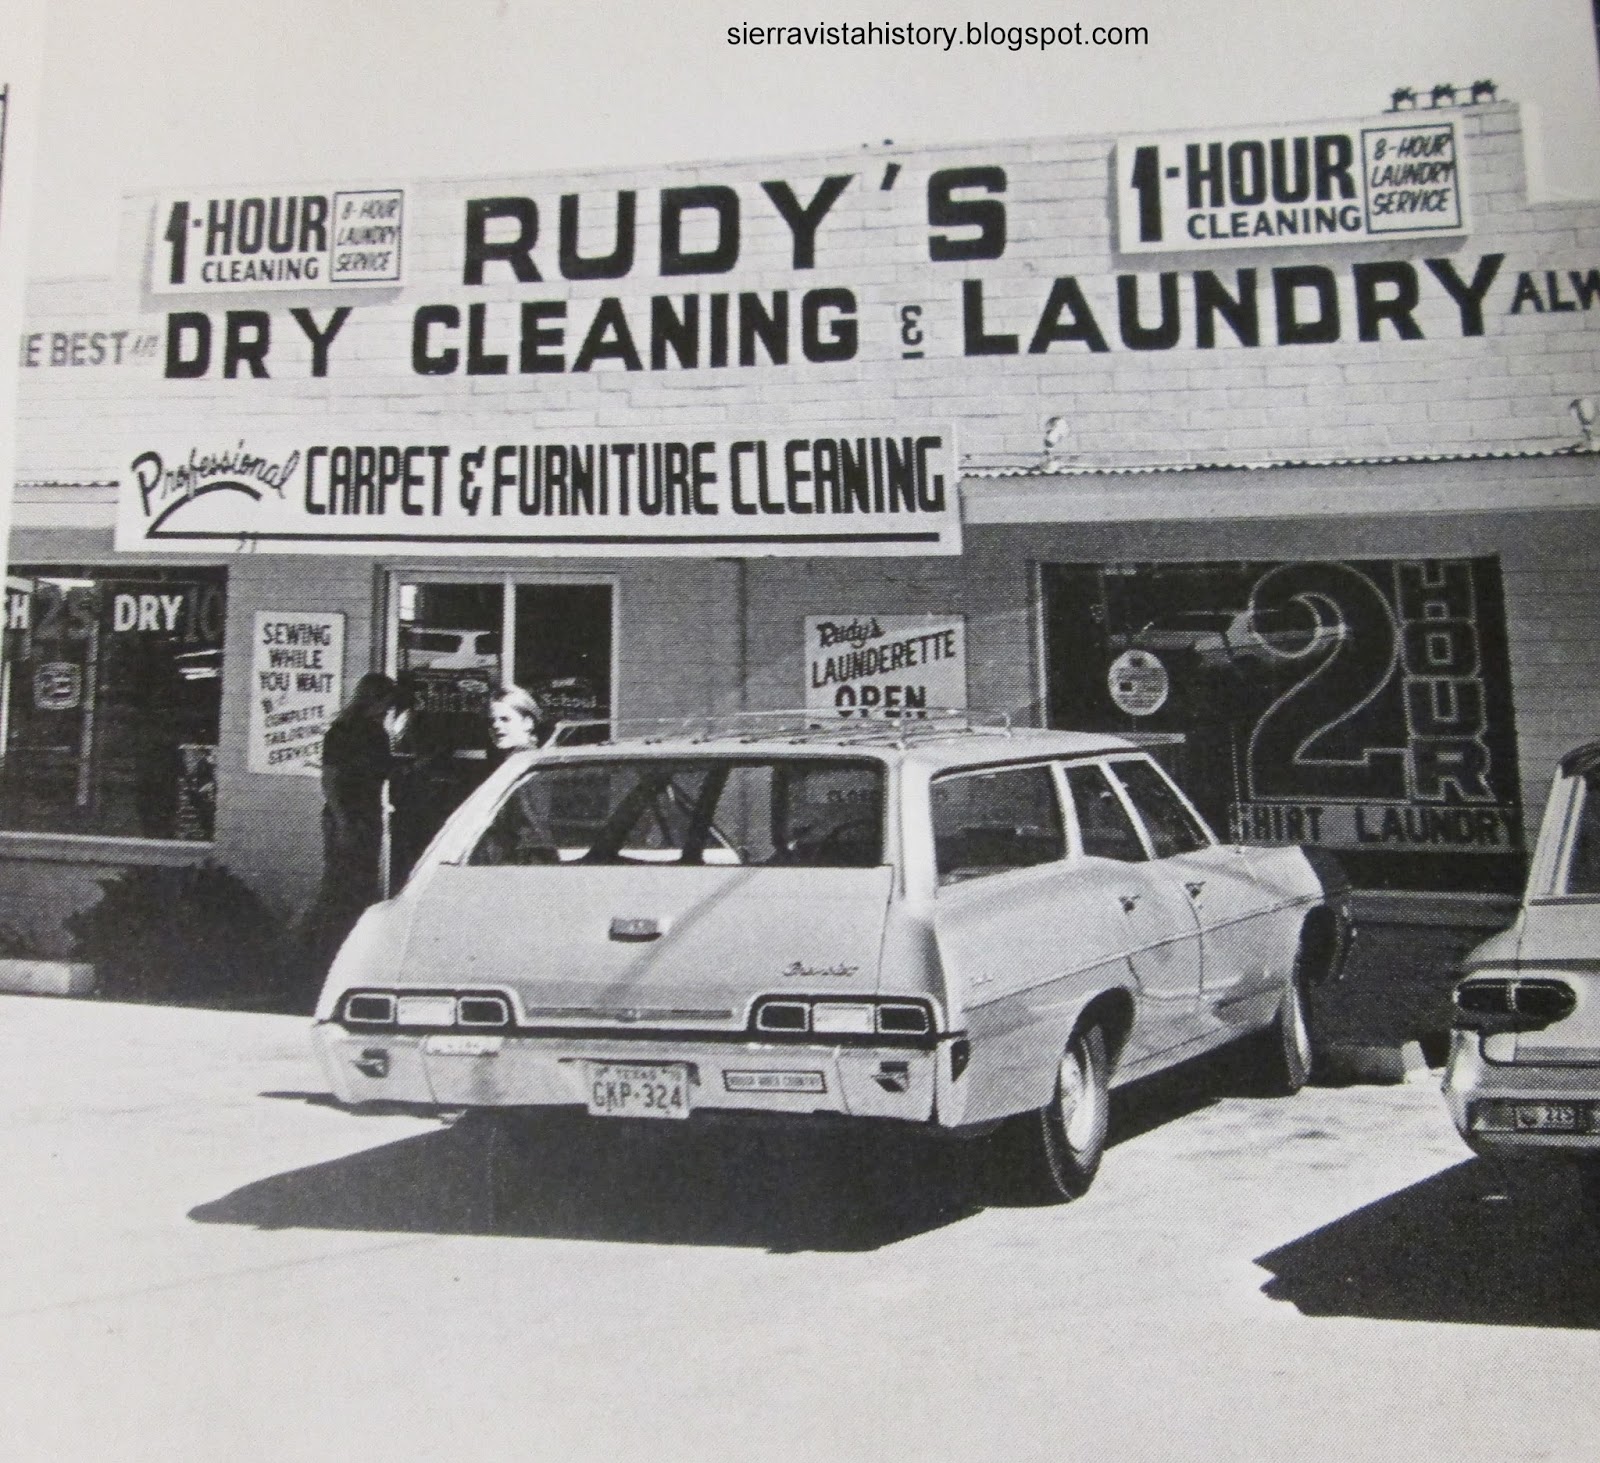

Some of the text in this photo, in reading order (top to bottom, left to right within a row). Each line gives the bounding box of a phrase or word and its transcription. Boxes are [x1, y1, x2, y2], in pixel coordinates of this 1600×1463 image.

[1375, 133, 1452, 160] 8-HOUR
[1132, 134, 1357, 242] 1-HOUR
[1371, 162, 1455, 188] LAUNDRY
[1372, 188, 1451, 215] SERVICE
[164, 195, 328, 284] 1-HOUR
[463, 164, 1007, 287] RUDY'S
[1187, 205, 1361, 240] CLEANING
[203, 257, 319, 283] CLEANING
[165, 307, 352, 379] DRY
[412, 288, 858, 376] CLEANING
[963, 253, 1505, 356] LAUNDRY
[50, 330, 128, 366] BEST
[131, 438, 300, 517] Professional
[305, 446, 450, 516] CARPET
[493, 442, 717, 516] FURNITURE
[730, 436, 945, 515] CLEANING
[113, 593, 184, 632] DRY
[263, 622, 332, 646] SEWING
[269, 649, 322, 669] WHILE
[811, 629, 956, 689] LAUNDERETTE
[259, 671, 334, 693] YOU WAIT
[1249, 560, 1405, 800] 2
[1393, 558, 1496, 802] HOUR
[835, 685, 927, 718] OPEN
